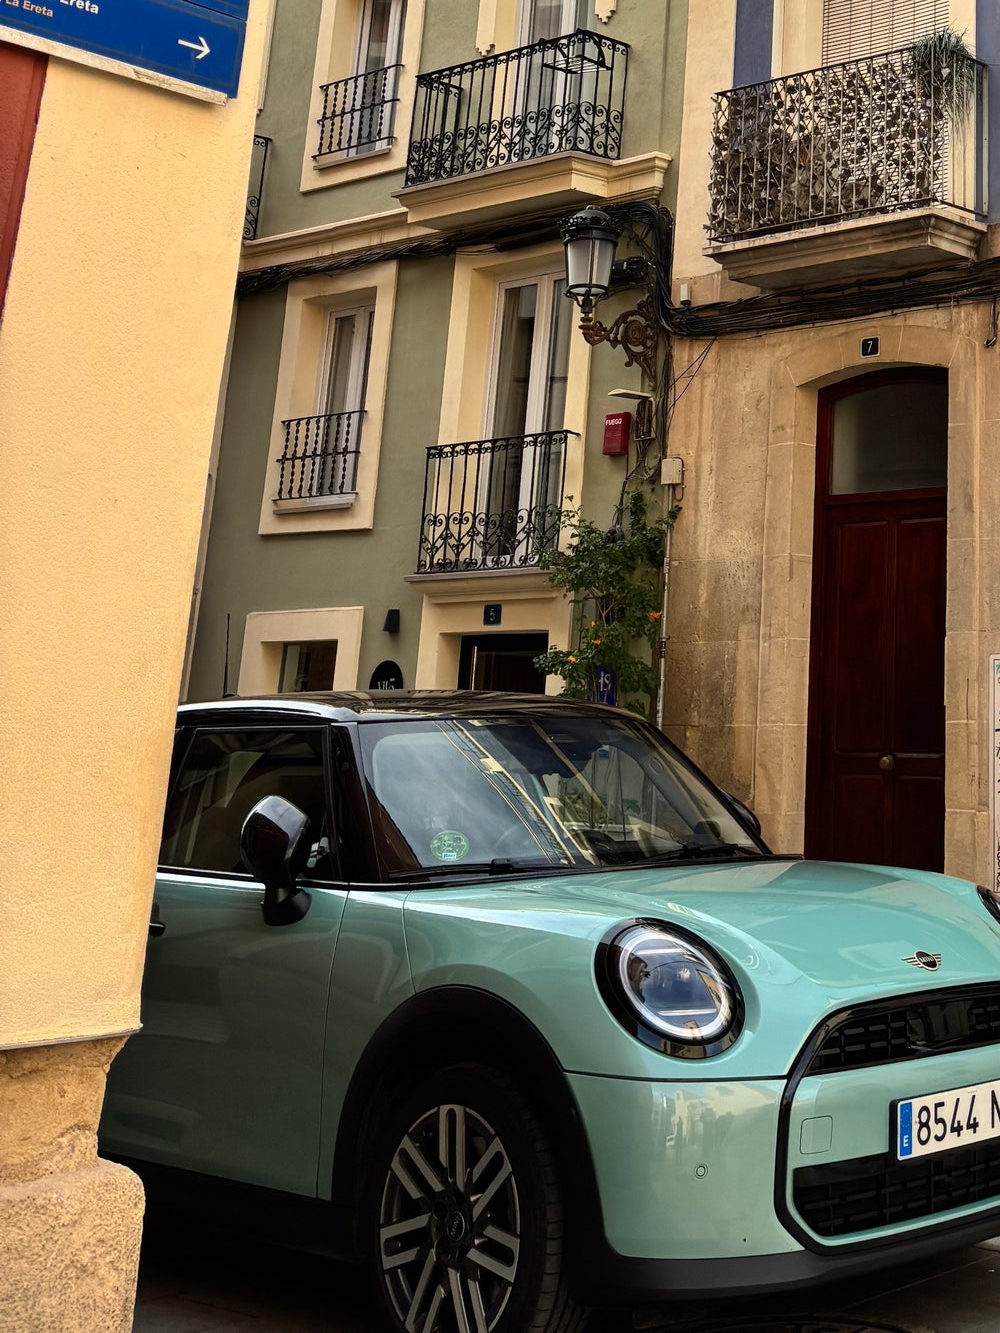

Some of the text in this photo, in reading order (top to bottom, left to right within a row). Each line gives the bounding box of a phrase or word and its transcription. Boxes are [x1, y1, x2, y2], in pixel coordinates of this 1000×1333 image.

[23, 0, 54, 18] Ereta
[867, 340, 873, 353] 7
[605, 418, 623, 426] FUEGO
[490, 608, 496, 621] 5
[903, 1135, 909, 1147] E
[917, 1095, 979, 1146] 8544
